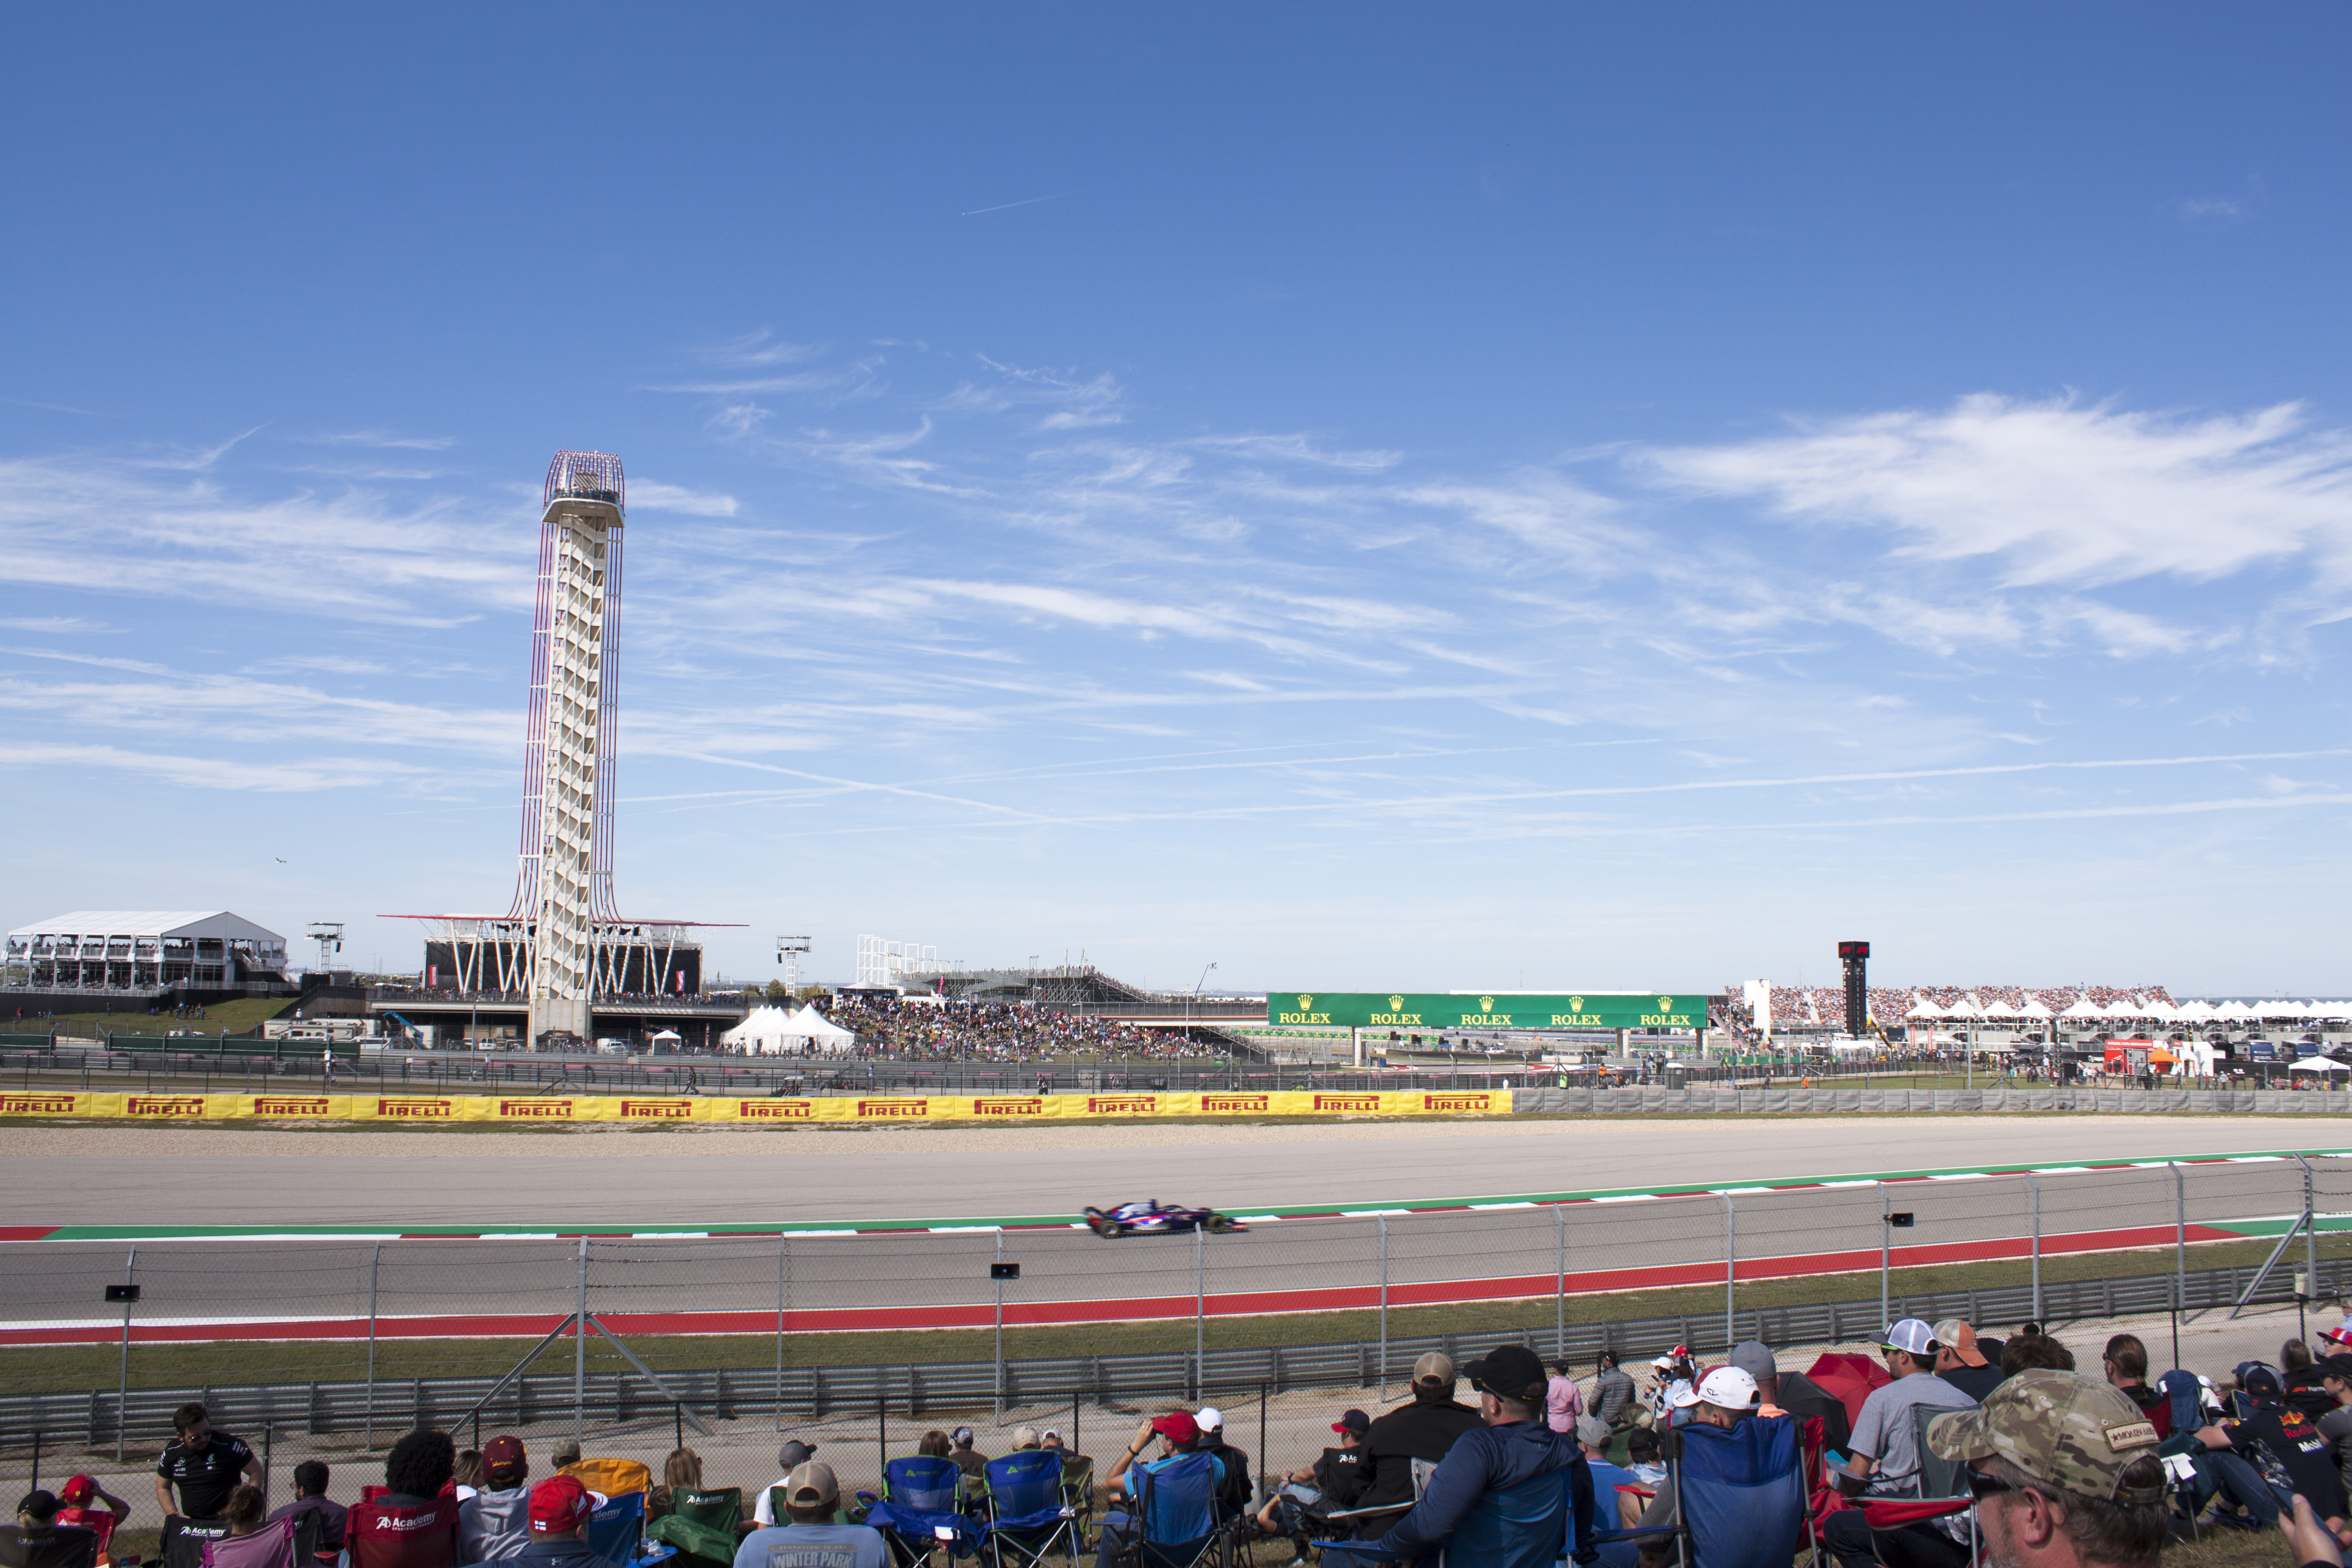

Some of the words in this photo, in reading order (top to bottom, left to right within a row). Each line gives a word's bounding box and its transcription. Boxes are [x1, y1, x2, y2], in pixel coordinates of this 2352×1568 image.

[1279, 1013, 1331, 1024] ROLEX
[1371, 1014, 1421, 1025] ROLEX
[1461, 1014, 1512, 1025] ROLEX
[1551, 1015, 1602, 1026] ROLEX
[1641, 1015, 1690, 1026] ROLEX
[0, 1095, 75, 1112] PIRELLI
[129, 1098, 204, 1115] PIRELLI
[255, 1098, 329, 1115] PIRELLI
[379, 1100, 451, 1117] PIRELLI
[501, 1101, 572, 1117] PIRELLI
[622, 1101, 692, 1117] PIRELLI
[741, 1102, 811, 1117] PIRELLI
[859, 1100, 928, 1117] PIRELLI
[975, 1099, 1042, 1115] PIRELLI
[1089, 1097, 1156, 1113] PIRELLI
[1203, 1096, 1269, 1111] PIRELLI
[1315, 1095, 1380, 1111] PIRELLI
[1425, 1095, 1489, 1110] PIRELLI
[392, 1512, 436, 1527] Academy
[593, 1507, 622, 1518] demy
[773, 1552, 818, 1568] WINTER
[820, 1552, 852, 1568] PARK
